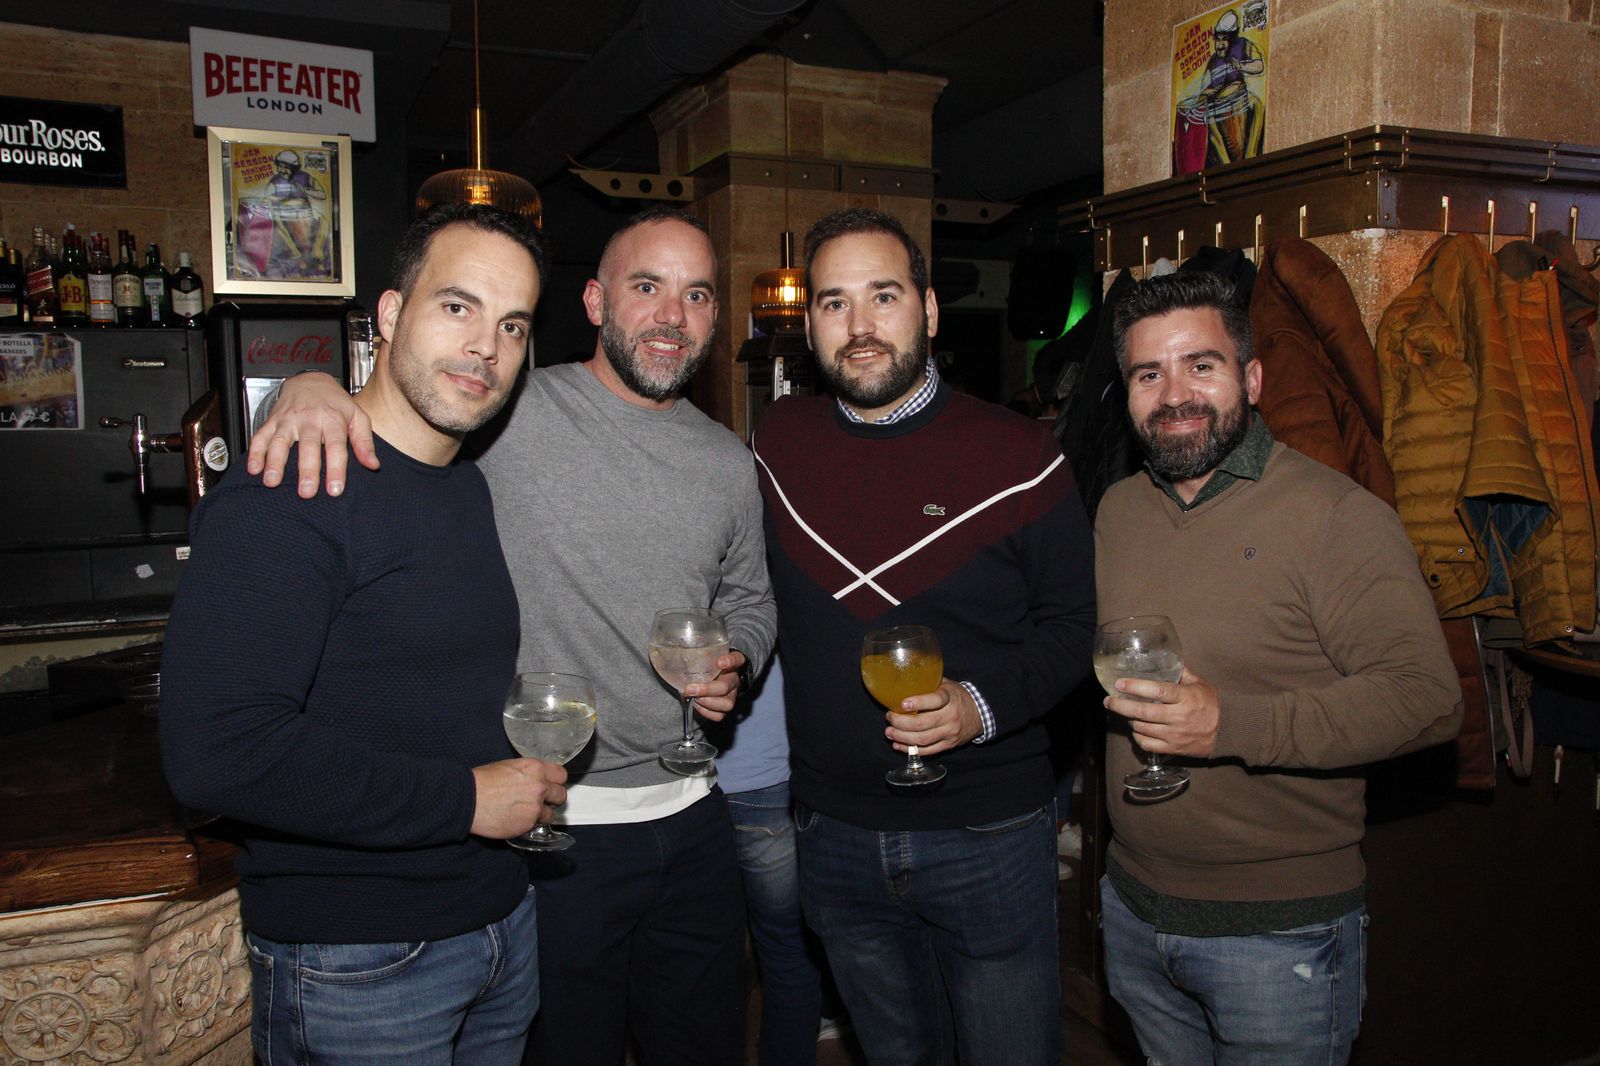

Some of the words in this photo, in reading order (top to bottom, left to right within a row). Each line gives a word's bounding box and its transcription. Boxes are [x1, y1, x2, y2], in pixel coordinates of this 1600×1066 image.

[1175, 26, 1214, 62] SESSION
[1184, 23, 1201, 43] JAM
[1180, 42, 1210, 70] DOMINGO
[204, 52, 361, 114] BEEFEATER
[247, 97, 322, 115] LONDON
[0, 123, 29, 146] ur
[0, 148, 83, 168] BOURBON
